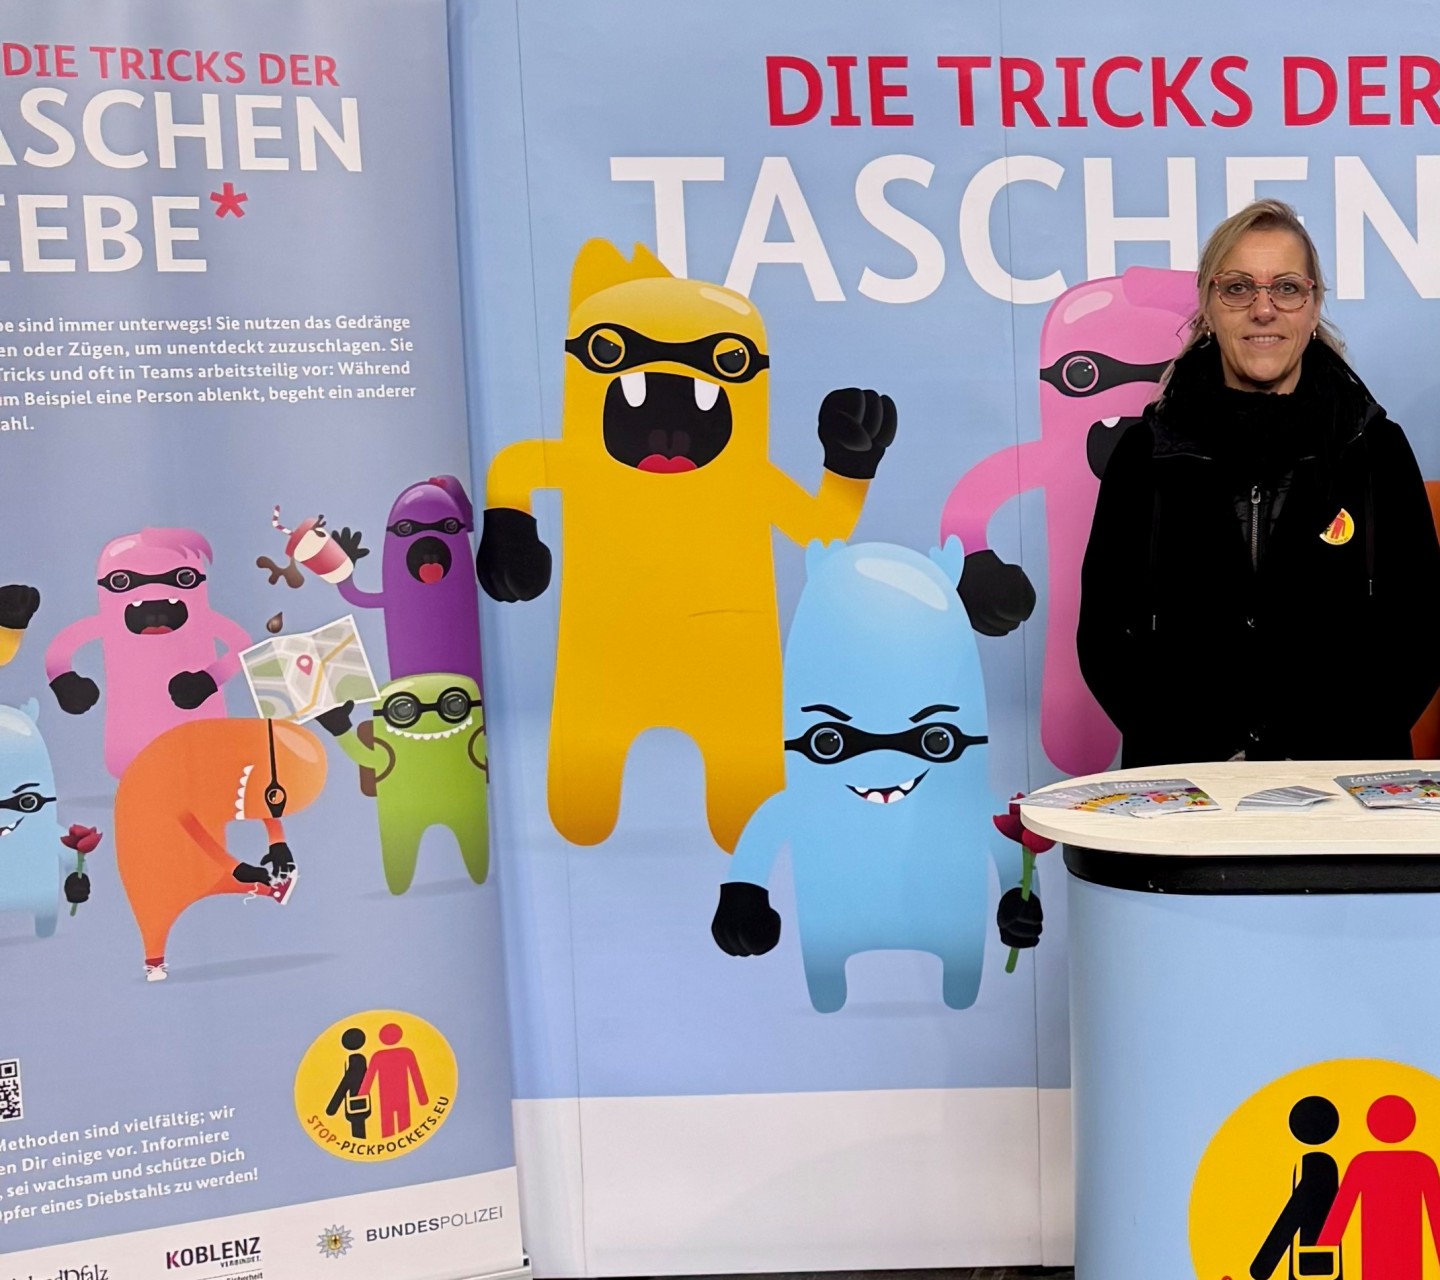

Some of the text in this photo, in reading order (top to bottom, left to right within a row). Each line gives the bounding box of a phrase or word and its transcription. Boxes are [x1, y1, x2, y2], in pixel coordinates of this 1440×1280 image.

[3, 42, 339, 87] DIE TRICKS DER
[765, 55, 914, 126] DIE
[938, 55, 1253, 127] TRICKS
[18, 315, 411, 334] sind immer unterwegs! Sie nutzen das Gedränge
[23, 338, 414, 360] oder Zügen, um unentdeckt zuzuschlagen. Sie
[50, 366, 83, 381] und
[88, 365, 115, 380] oft
[119, 365, 135, 380] in
[138, 365, 194, 379] Teams
[198, 363, 299, 380] arbeitsteilig
[302, 365, 334, 377] vor:
[338, 361, 410, 375] Während
[84, 1121, 119, 1139] sind
[124, 1111, 205, 1133] vielfältig;
[209, 1105, 236, 1120] wir
[307, 1096, 449, 1156] STOP-PICKPOCKETS.EU
[22, 1131, 230, 1172] Dir einige vor. Informiere
[7, 1148, 245, 1197] sei wachsam und schütze Dich
[41, 1199, 83, 1214] eines
[87, 1183, 172, 1207] Diebstahls
[174, 1181, 192, 1193] zu
[196, 1167, 258, 1189] werden!
[366, 1205, 503, 1242] BUNDESPOLIZEI
[166, 1236, 261, 1270] KOBLENZ
